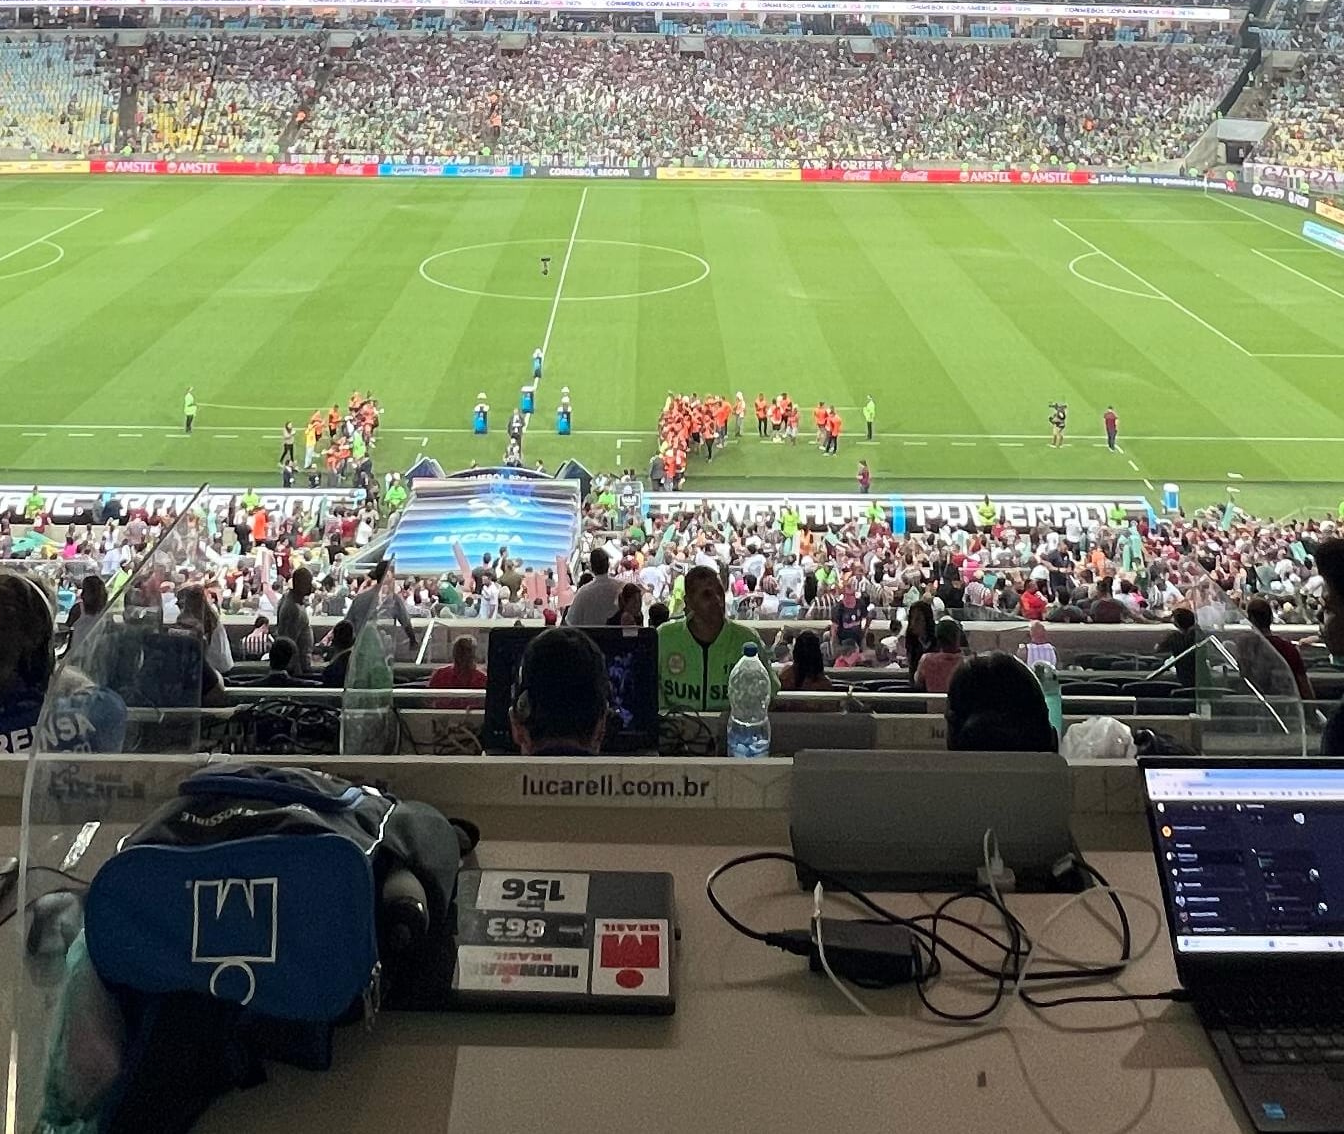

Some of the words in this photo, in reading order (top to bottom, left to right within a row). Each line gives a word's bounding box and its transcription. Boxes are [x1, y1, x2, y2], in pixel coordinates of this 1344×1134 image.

[116, 162, 156, 173] AMSTEL
[177, 162, 219, 173] AMSTEL
[970, 171, 1010, 182] AMSTEL
[1032, 171, 1072, 182] AMSTEL
[664, 679, 700, 700] SUN
[522, 774, 710, 797] lucareli.com.br
[502, 878, 565, 902] 156
[486, 917, 546, 939] 863
[602, 923, 660, 933] BRASIL
[496, 952, 553, 962] BRASIL
